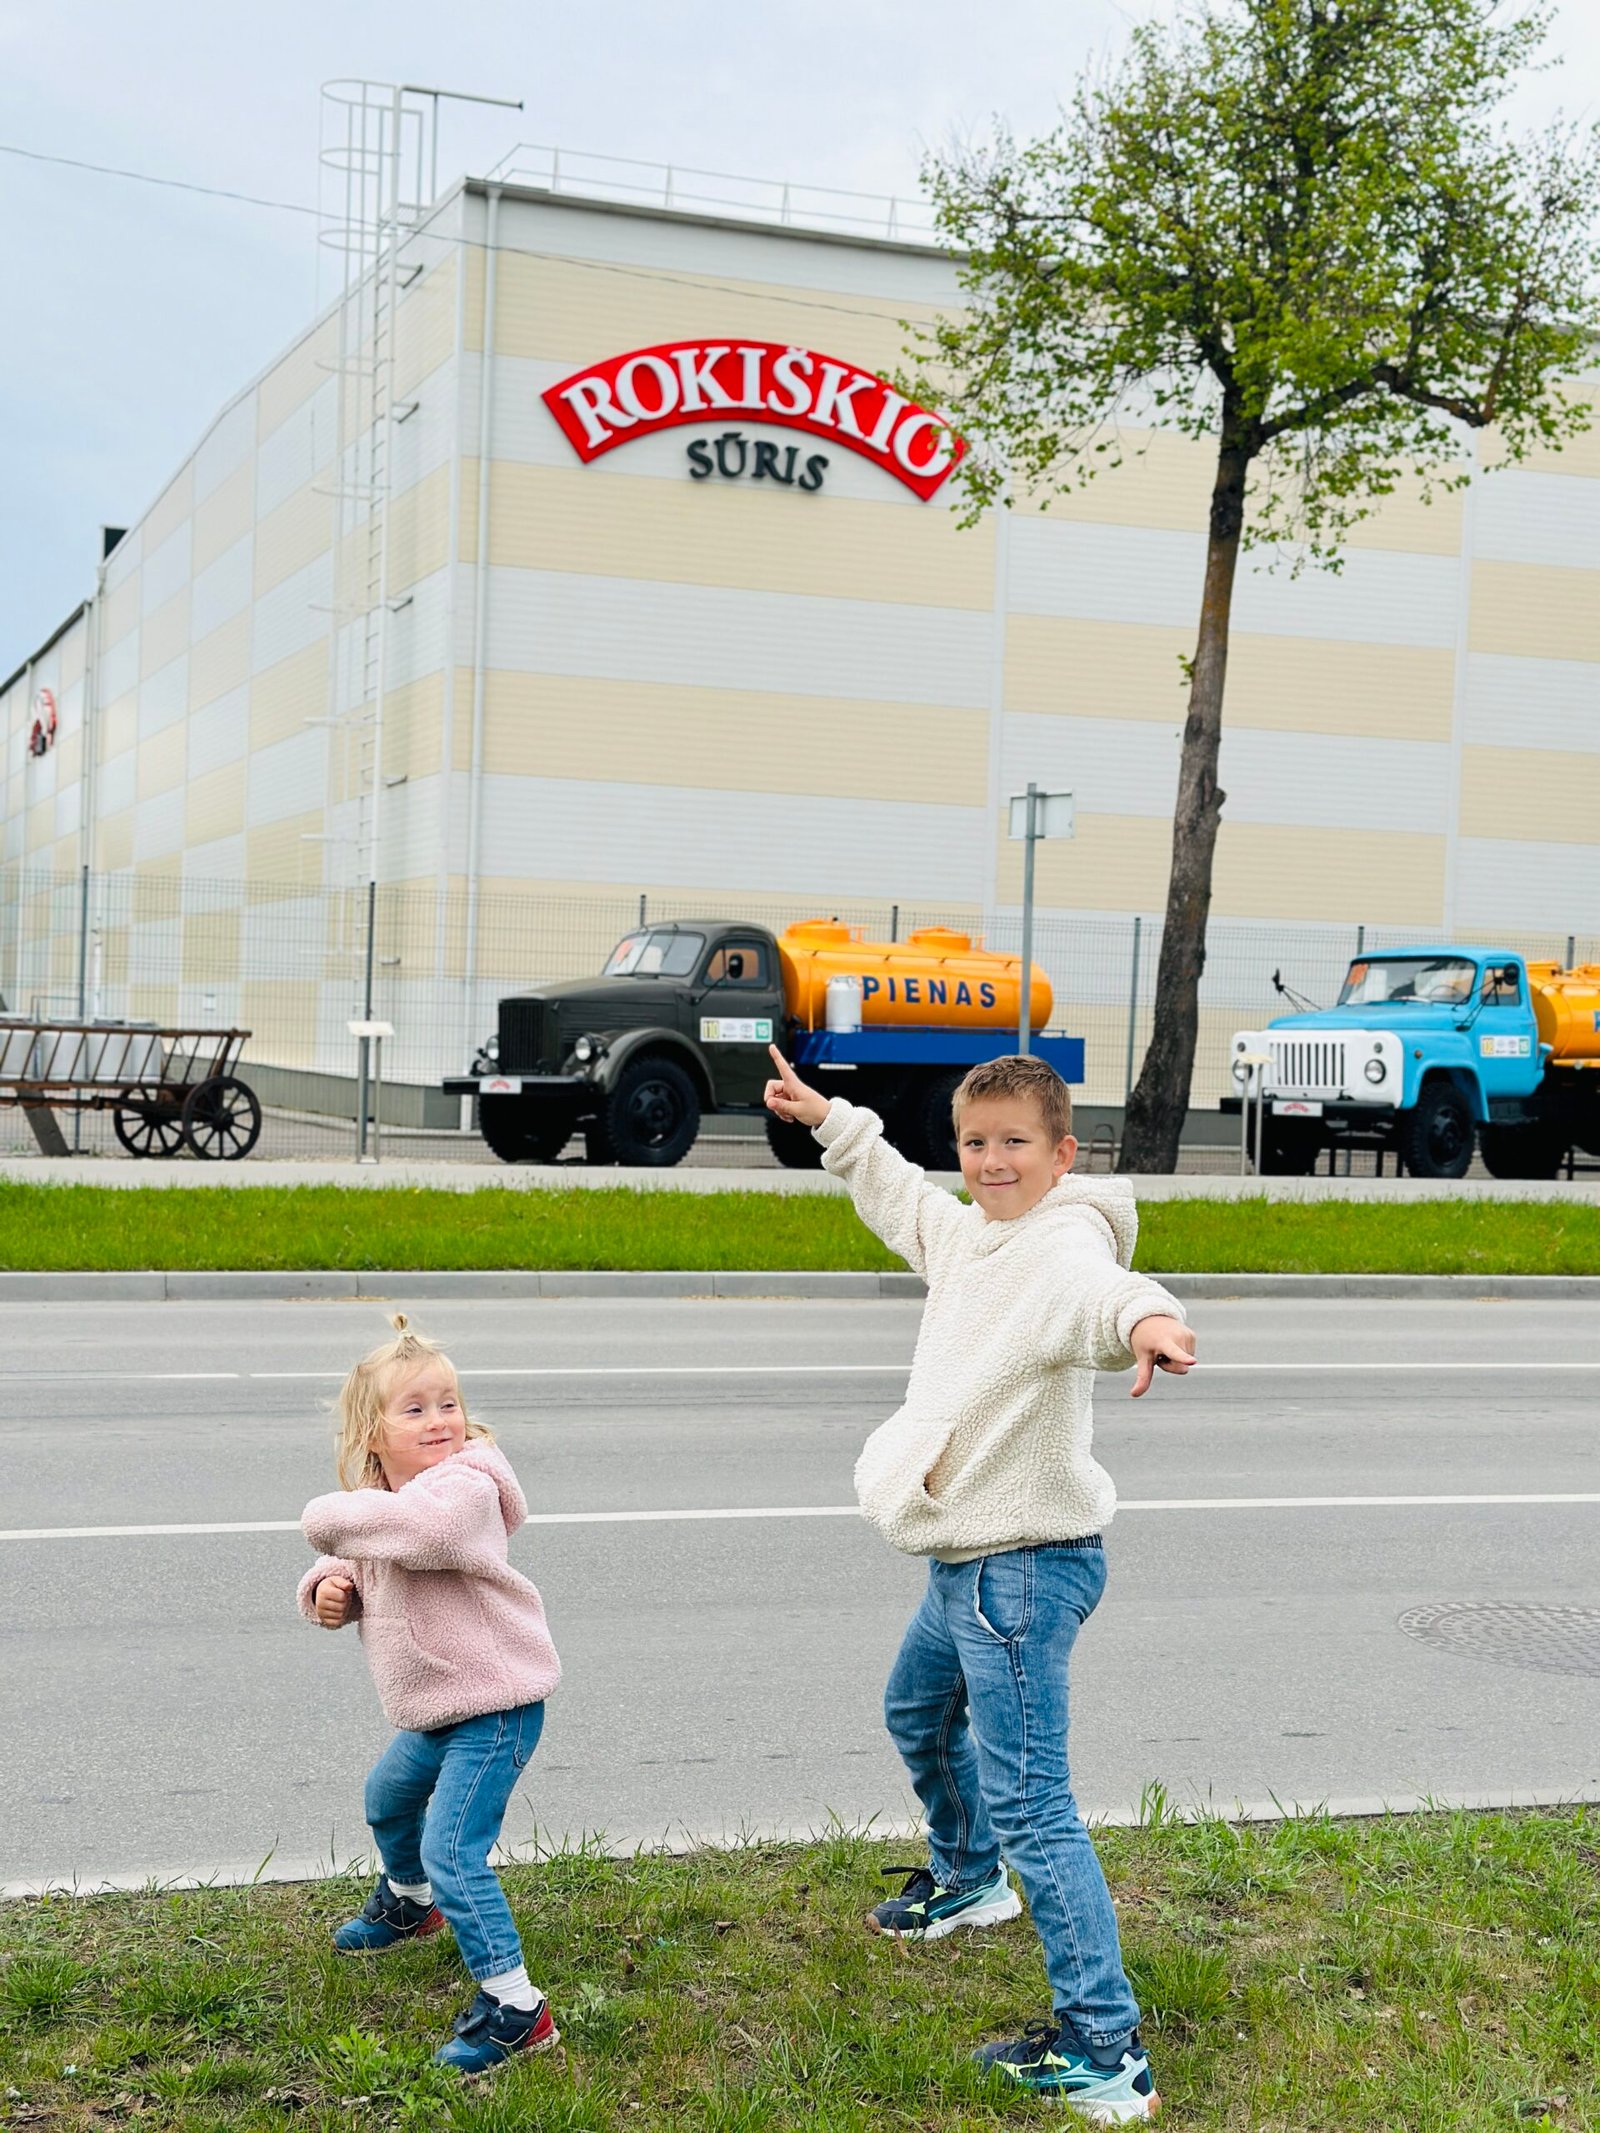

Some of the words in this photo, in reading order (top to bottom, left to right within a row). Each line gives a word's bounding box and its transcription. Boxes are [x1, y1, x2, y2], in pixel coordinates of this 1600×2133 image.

[560, 346, 954, 477] ROKIŠKIO
[687, 432, 829, 491] SŪRIS
[861, 975, 996, 1009] PIENAS
